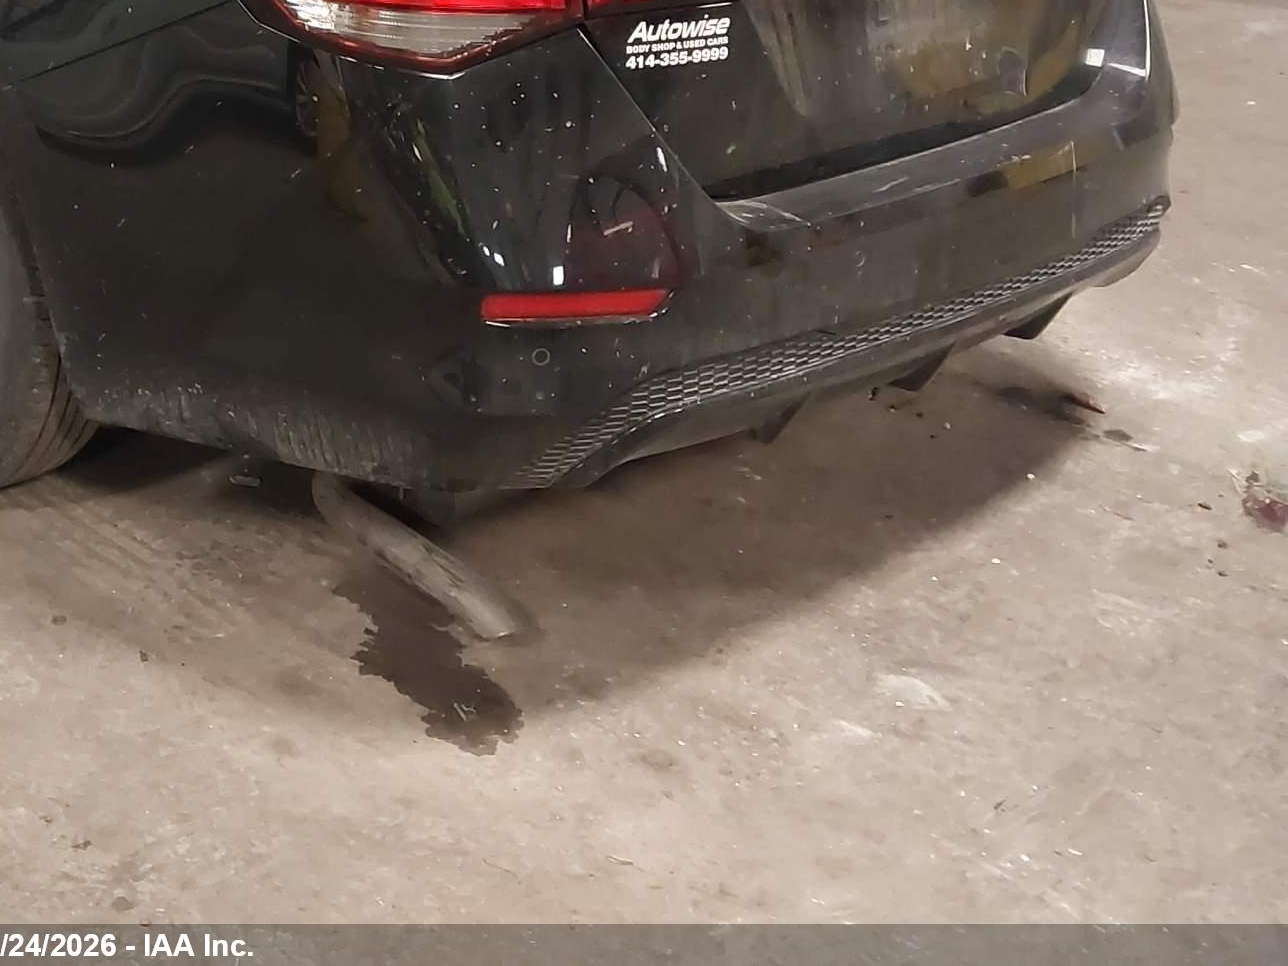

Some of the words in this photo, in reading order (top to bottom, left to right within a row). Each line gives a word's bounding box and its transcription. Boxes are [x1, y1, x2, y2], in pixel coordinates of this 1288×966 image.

[627, 14, 731, 43] Autowise
[626, 44, 650, 54] BODY
[651, 41, 674, 52] SHOP
[676, 41, 683, 49] &
[683, 39, 706, 49] USED
[707, 36, 728, 46] CARS
[625, 46, 729, 69] 414-355-9999
